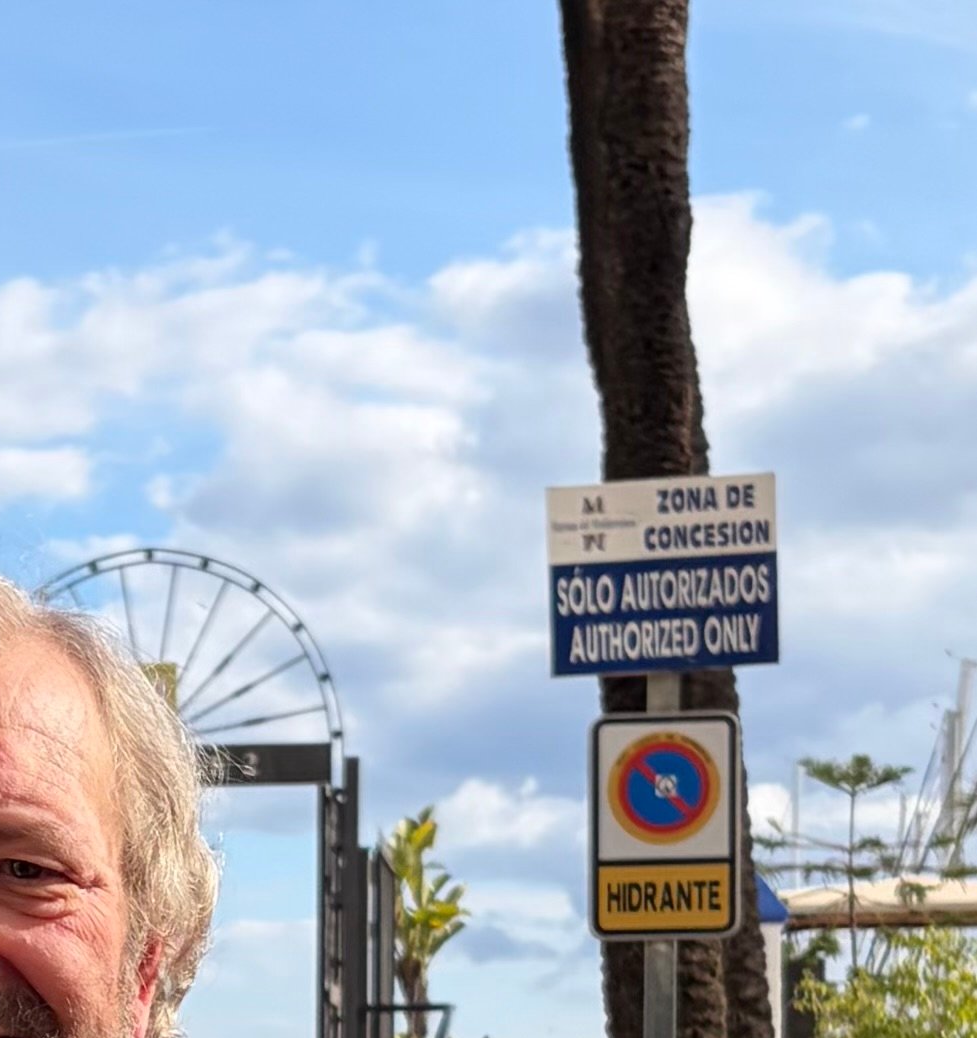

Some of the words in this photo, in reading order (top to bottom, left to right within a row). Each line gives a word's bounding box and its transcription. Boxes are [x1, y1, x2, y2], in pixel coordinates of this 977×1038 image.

[656, 486, 719, 514] ZONA
[726, 484, 755, 509] DE
[644, 520, 770, 550] CONCESION
[557, 566, 615, 616] SÓLO
[621, 564, 770, 611] AUTORIZADOS
[569, 618, 699, 663] AUTHORIZED
[704, 613, 761, 655] ONLY
[607, 880, 721, 913] HIDRANTE
